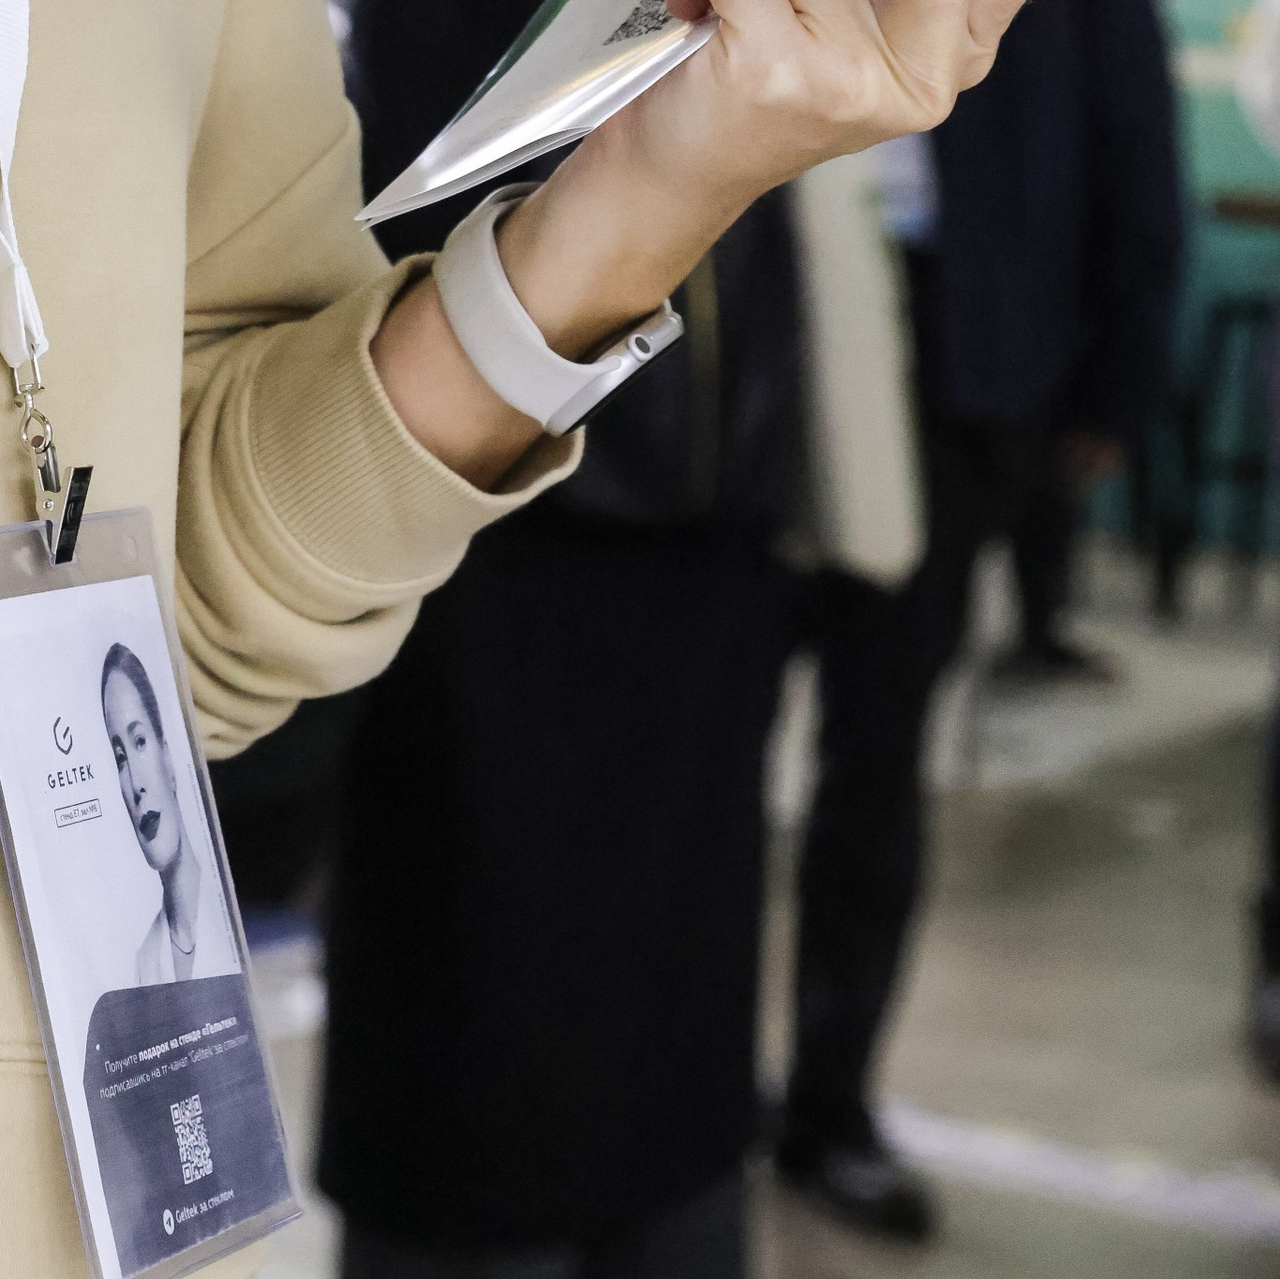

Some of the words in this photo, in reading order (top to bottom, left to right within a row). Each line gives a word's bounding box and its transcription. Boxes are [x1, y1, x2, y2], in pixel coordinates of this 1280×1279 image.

[47, 764, 94, 788] GELTEK
[104, 1053, 138, 1074] Получите
[138, 1042, 170, 1061] подарок
[151, 1067, 161, 1080] на
[176, 1203, 199, 1223] Geltek
